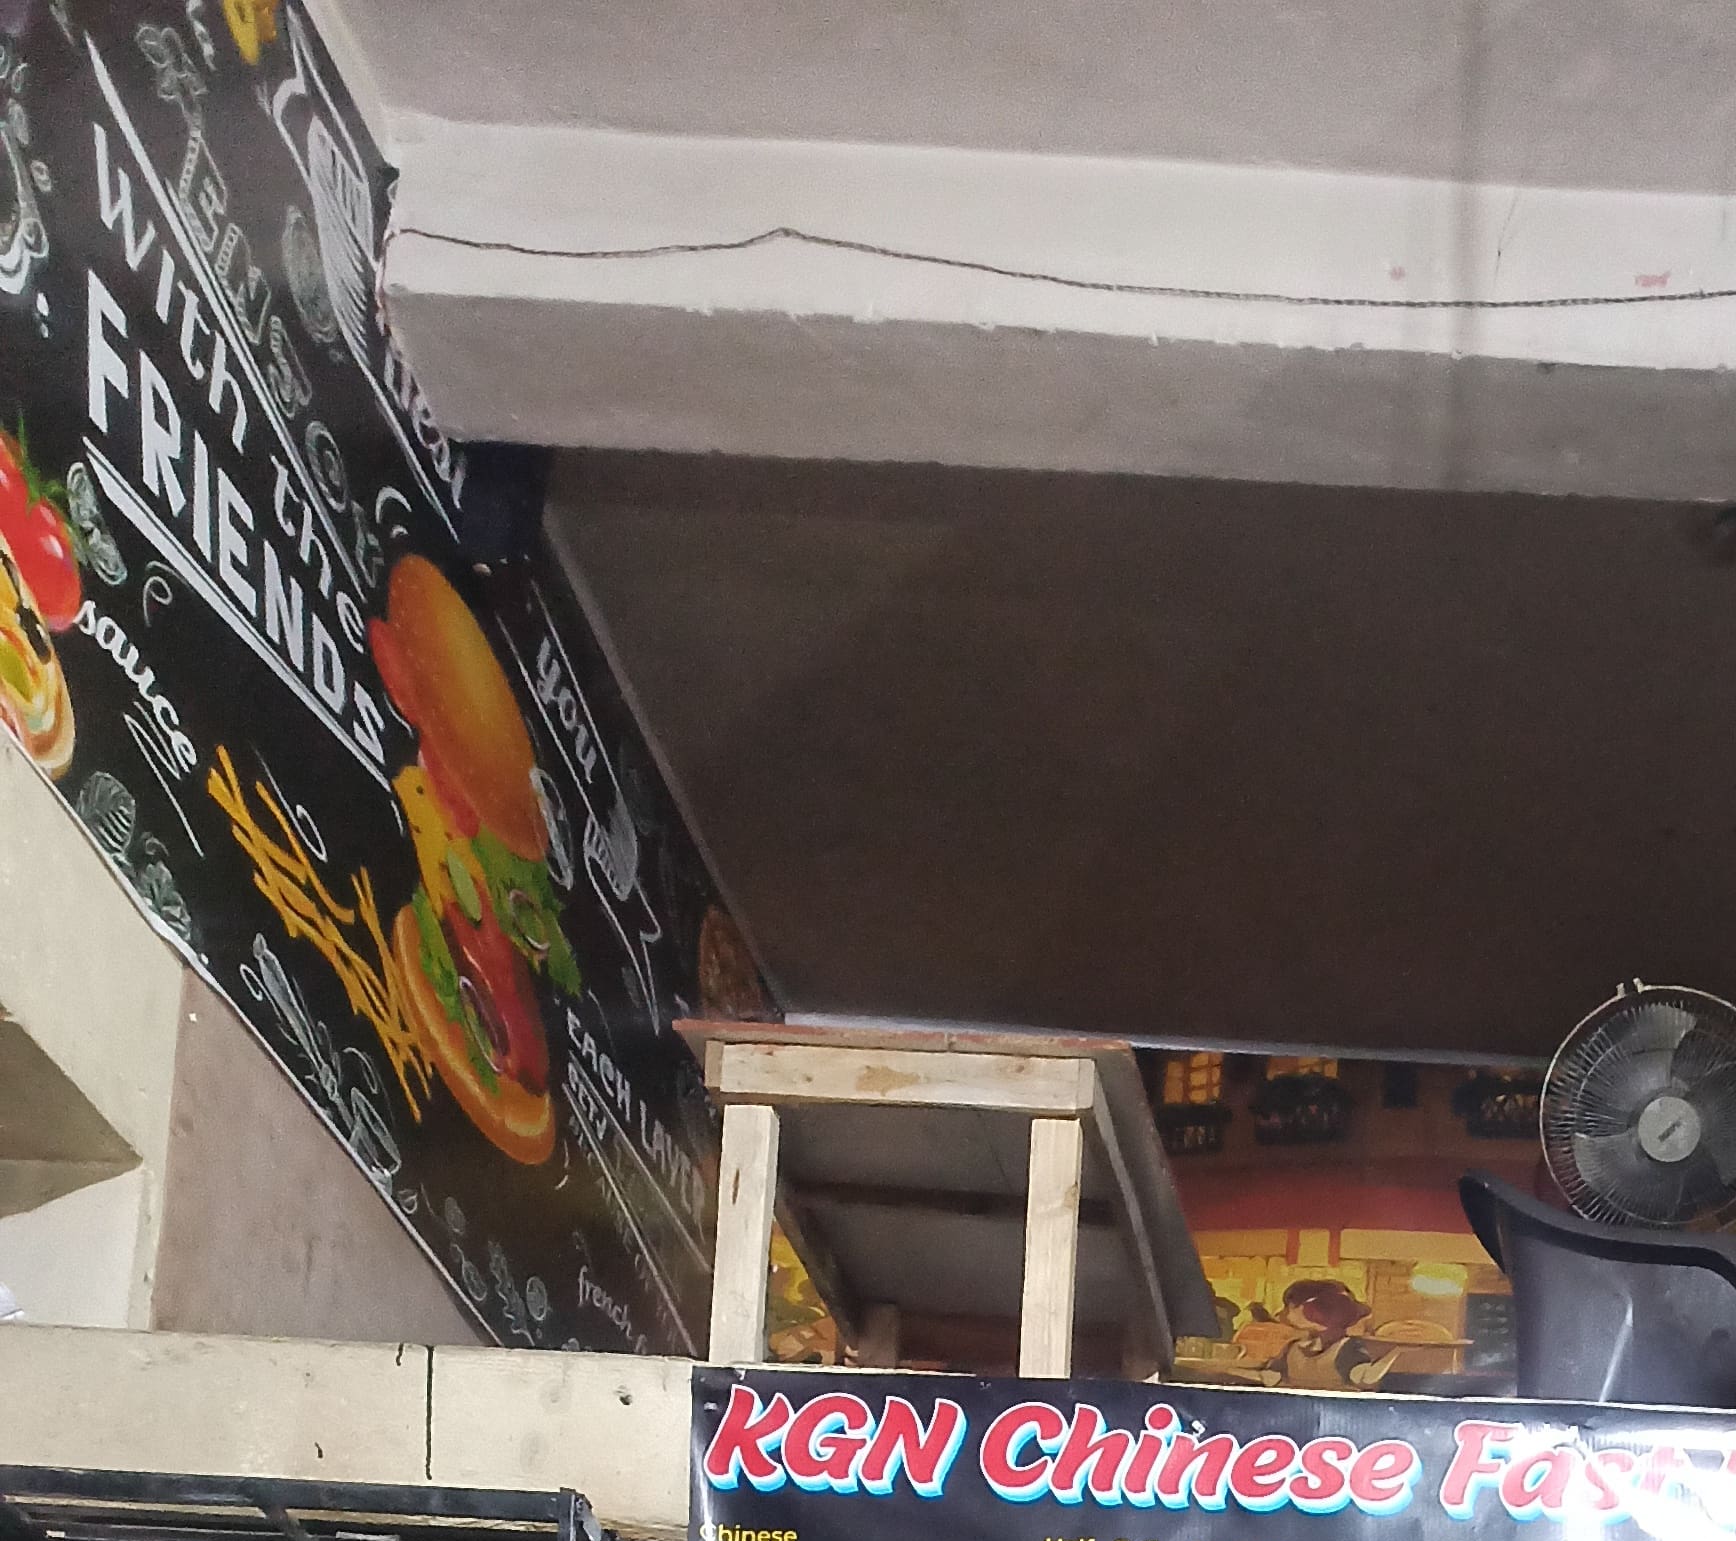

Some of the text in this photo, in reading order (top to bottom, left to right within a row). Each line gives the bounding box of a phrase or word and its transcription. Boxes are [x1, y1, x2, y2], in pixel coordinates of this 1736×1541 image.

[88, 269, 388, 763] FRIENDS
[703, 1384, 968, 1498] KGN
[980, 1402, 1423, 1511] Chinese
